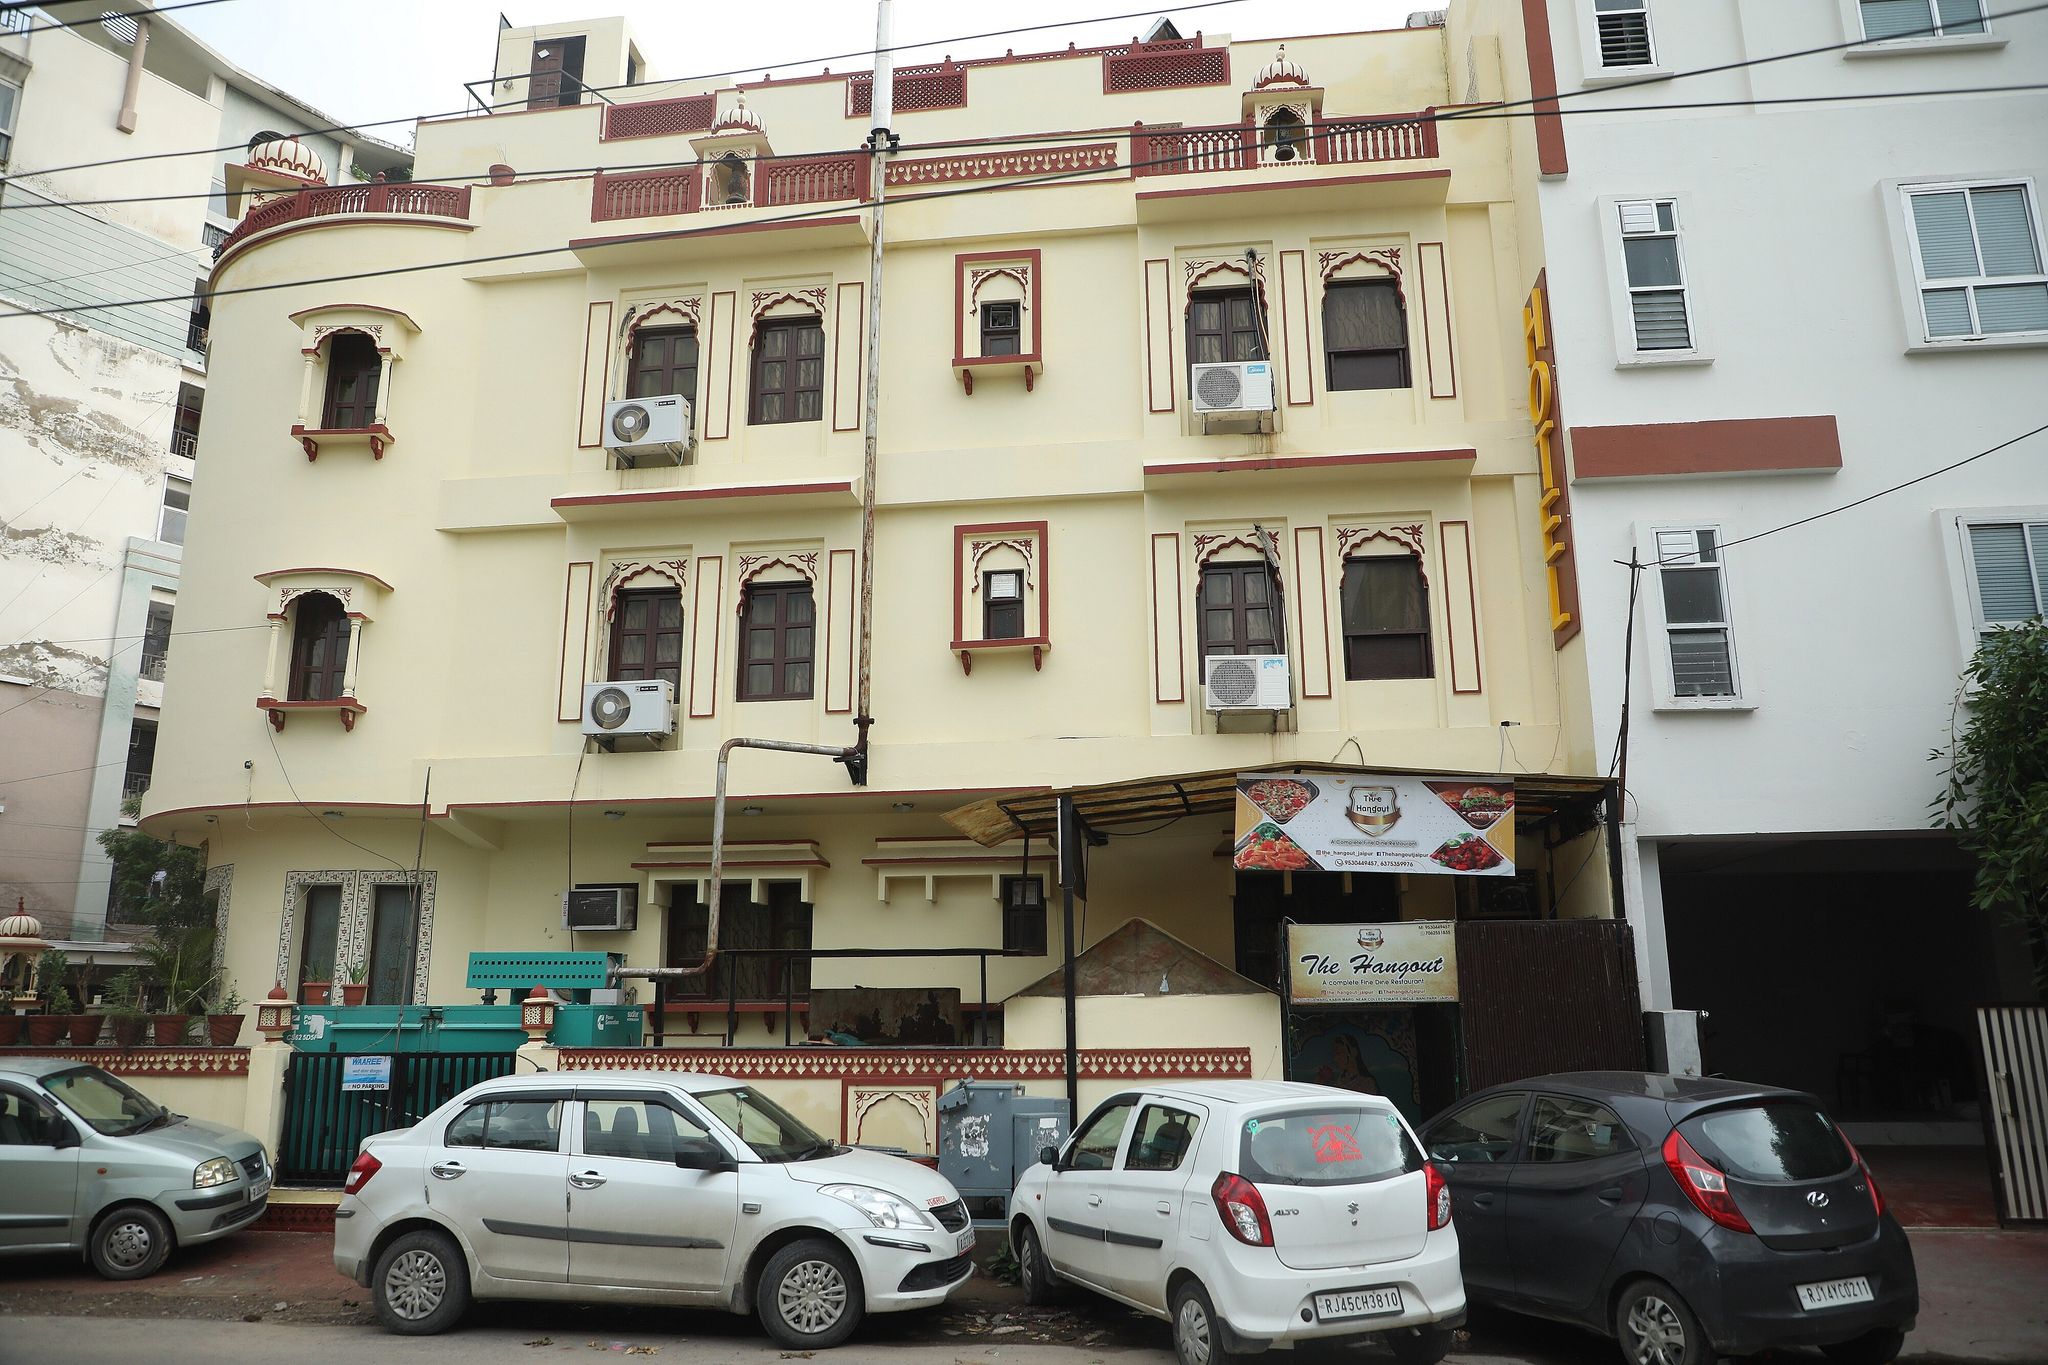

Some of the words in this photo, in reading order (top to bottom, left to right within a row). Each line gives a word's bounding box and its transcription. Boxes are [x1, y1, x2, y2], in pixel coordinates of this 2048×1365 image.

[1523, 287, 1571, 632] HOTEL
[1364, 794, 1382, 802] The
[1356, 804, 1389, 813] Hangout
[1300, 955, 1340, 975] The
[1349, 954, 1443, 980] Hangout
[352, 1058, 382, 1066] WAAREE
[1273, 1208, 1299, 1216] ALTO
[1806, 1280, 1869, 1303] RJ14YC0211
[1325, 1292, 1398, 1314] RJ45CH3810
